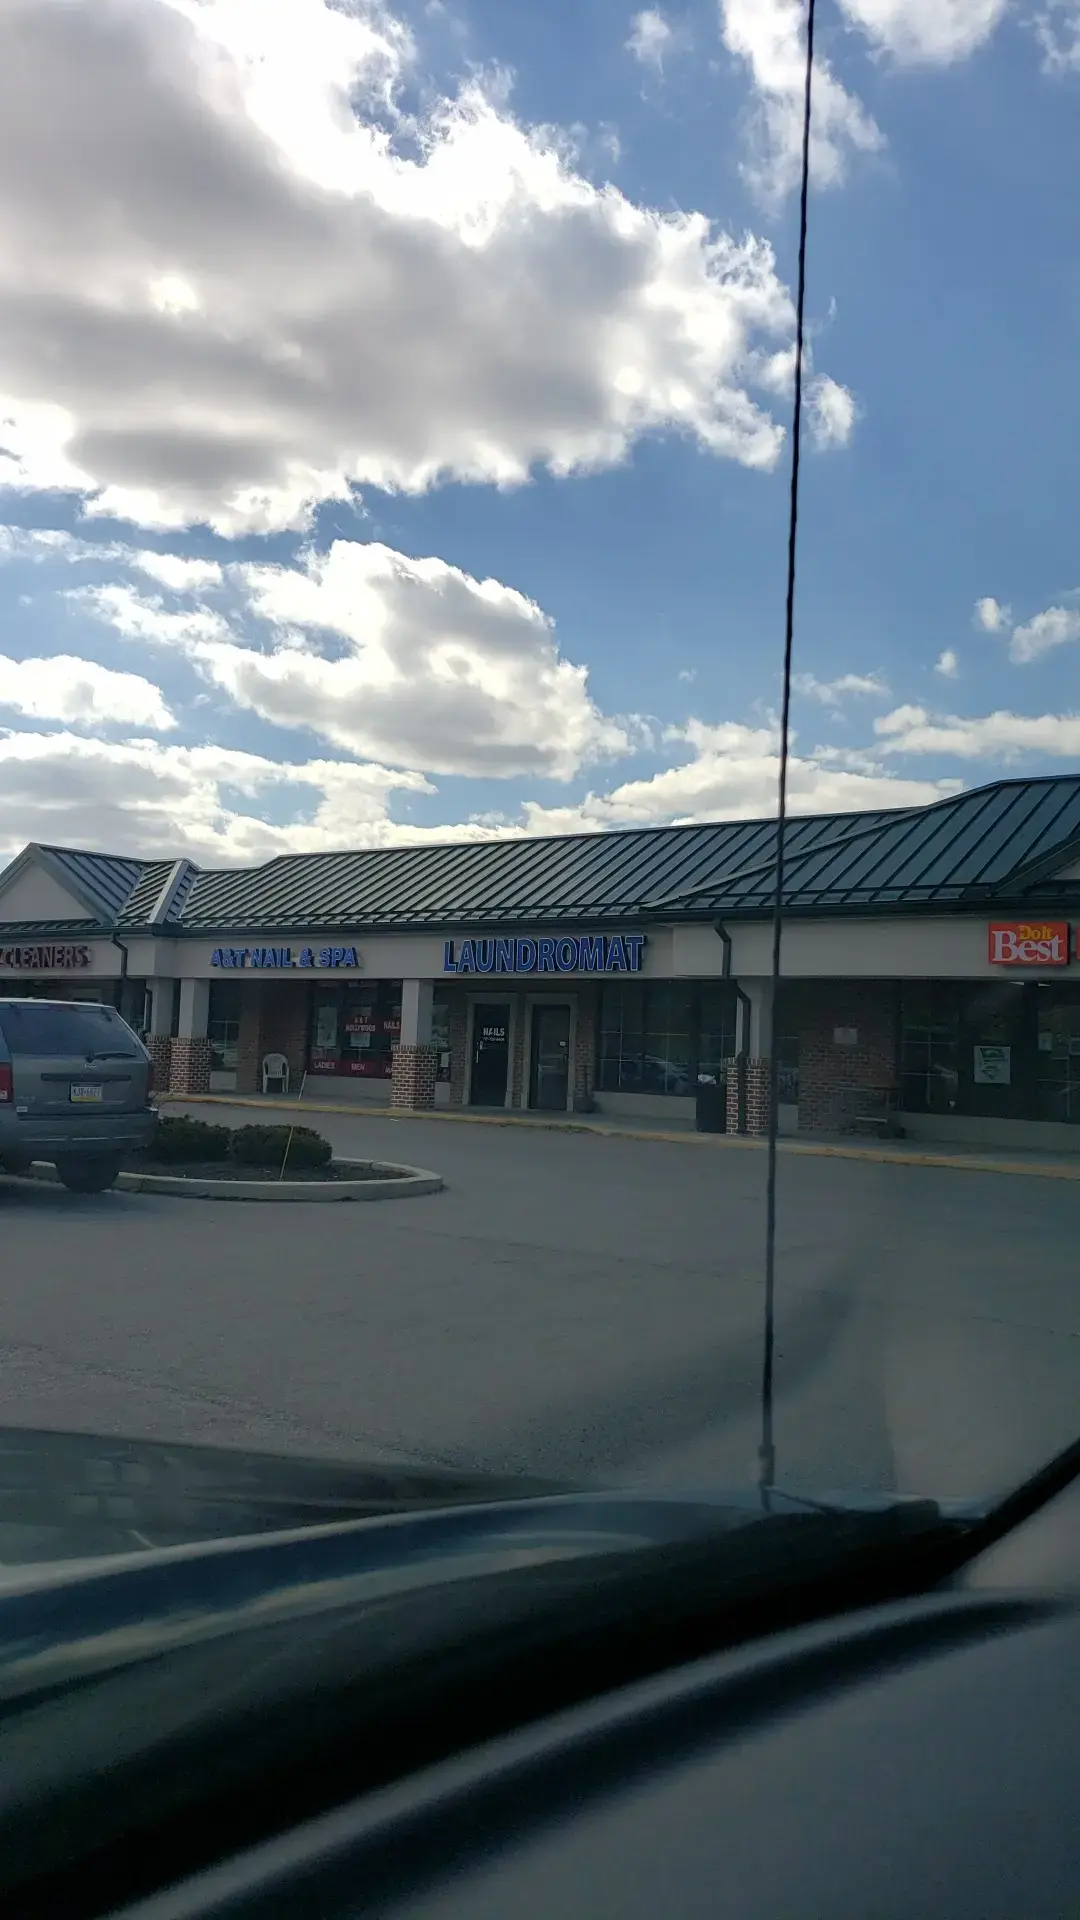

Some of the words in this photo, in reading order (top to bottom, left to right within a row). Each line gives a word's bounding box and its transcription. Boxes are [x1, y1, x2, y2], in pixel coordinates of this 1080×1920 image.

[1017, 925, 1040, 939] Do
[991, 930, 1065, 961] Best
[250, 948, 293, 968] NAIL
[299, 947, 313, 968] &
[319, 947, 358, 968] SPA
[443, 935, 646, 973] LAUNDROMAT
[384, 1021, 400, 1029] NAILS
[483, 1027, 505, 1036] NAILS
[314, 1060, 335, 1069] LADIES
[350, 1063, 366, 1071] MEN
